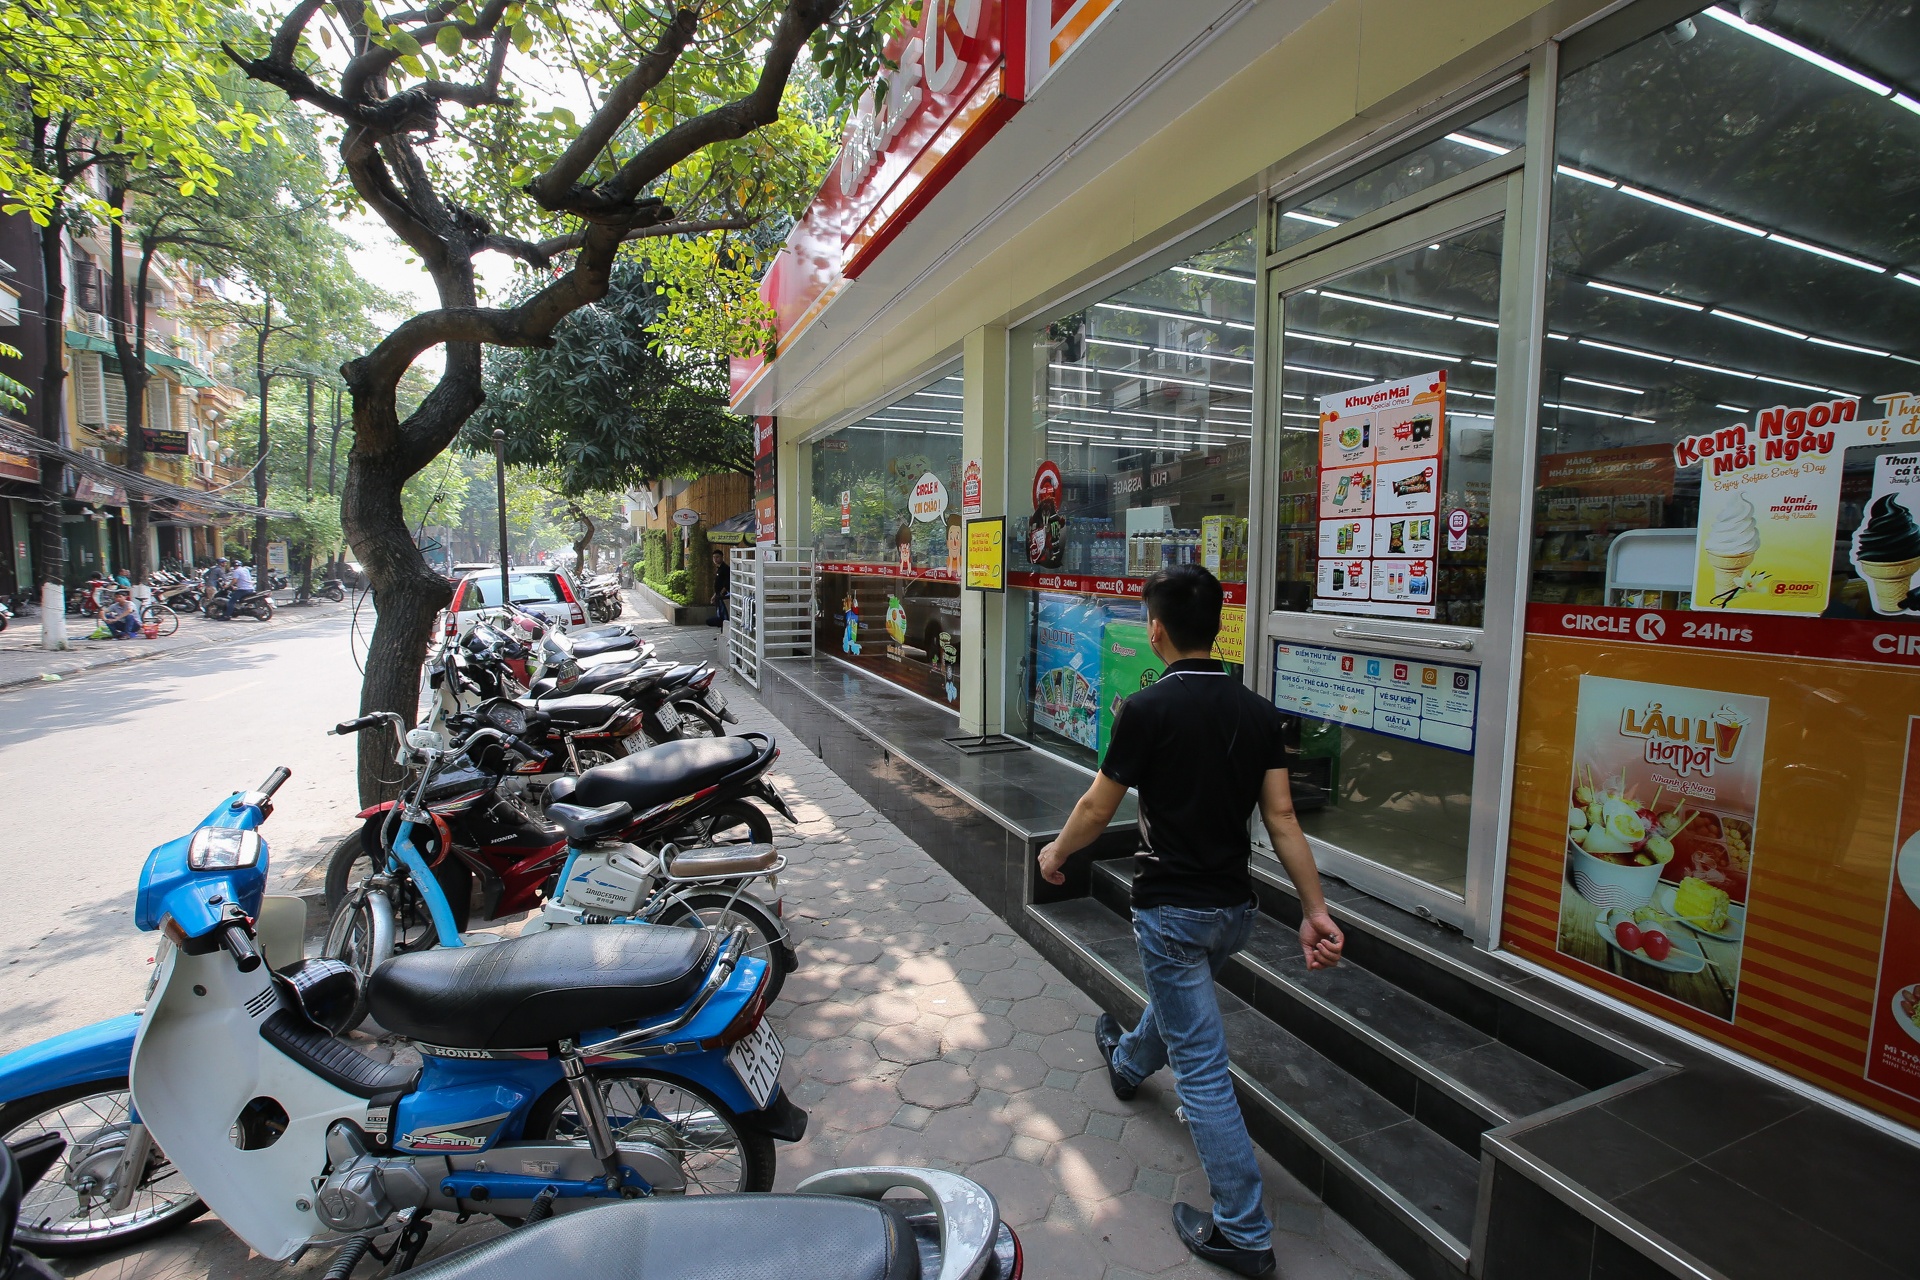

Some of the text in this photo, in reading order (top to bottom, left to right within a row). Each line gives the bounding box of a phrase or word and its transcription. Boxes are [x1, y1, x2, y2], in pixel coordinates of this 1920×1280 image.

[1371, 398, 1410, 411] Special Offers
[1676, 400, 1857, 467] Kem Ngon
[1714, 430, 1835, 476] Mỗi Ngày
[1885, 456, 1917, 466] Than
[1714, 478, 1739, 491] Enjoy
[1771, 466, 1800, 478] Every
[1802, 462, 1827, 475] Day
[1895, 466, 1910, 476] cá
[916, 482, 933, 496] CIRCLE
[914, 502, 923, 514] XIN
[923, 498, 938, 513] CHÀO
[1783, 495, 1807, 504] Vani
[1770, 500, 1818, 513] may mắn
[1792, 512, 1817, 520] Vanilla
[1039, 577, 1055, 586] CIRCLE
[1063, 579, 1077, 588] 24hrs
[1096, 579, 1143, 594] CIRCLE K 24hr
[1562, 613, 1753, 642] CIRCLE K 24hrs
[1048, 629, 1075, 646] LOTTE
[1347, 687, 1365, 695] GAME
[1651, 774, 1715, 795] Nhanh & Ngon
[490, 833, 518, 844] HONDA
[435, 1047, 494, 1059] HONDA
[1883, 1053, 1908, 1065] MIXED
[749, 1031, 782, 1102] 771.37
[1882, 1059, 1899, 1068] MINI
[401, 1132, 471, 1146] DREAM
